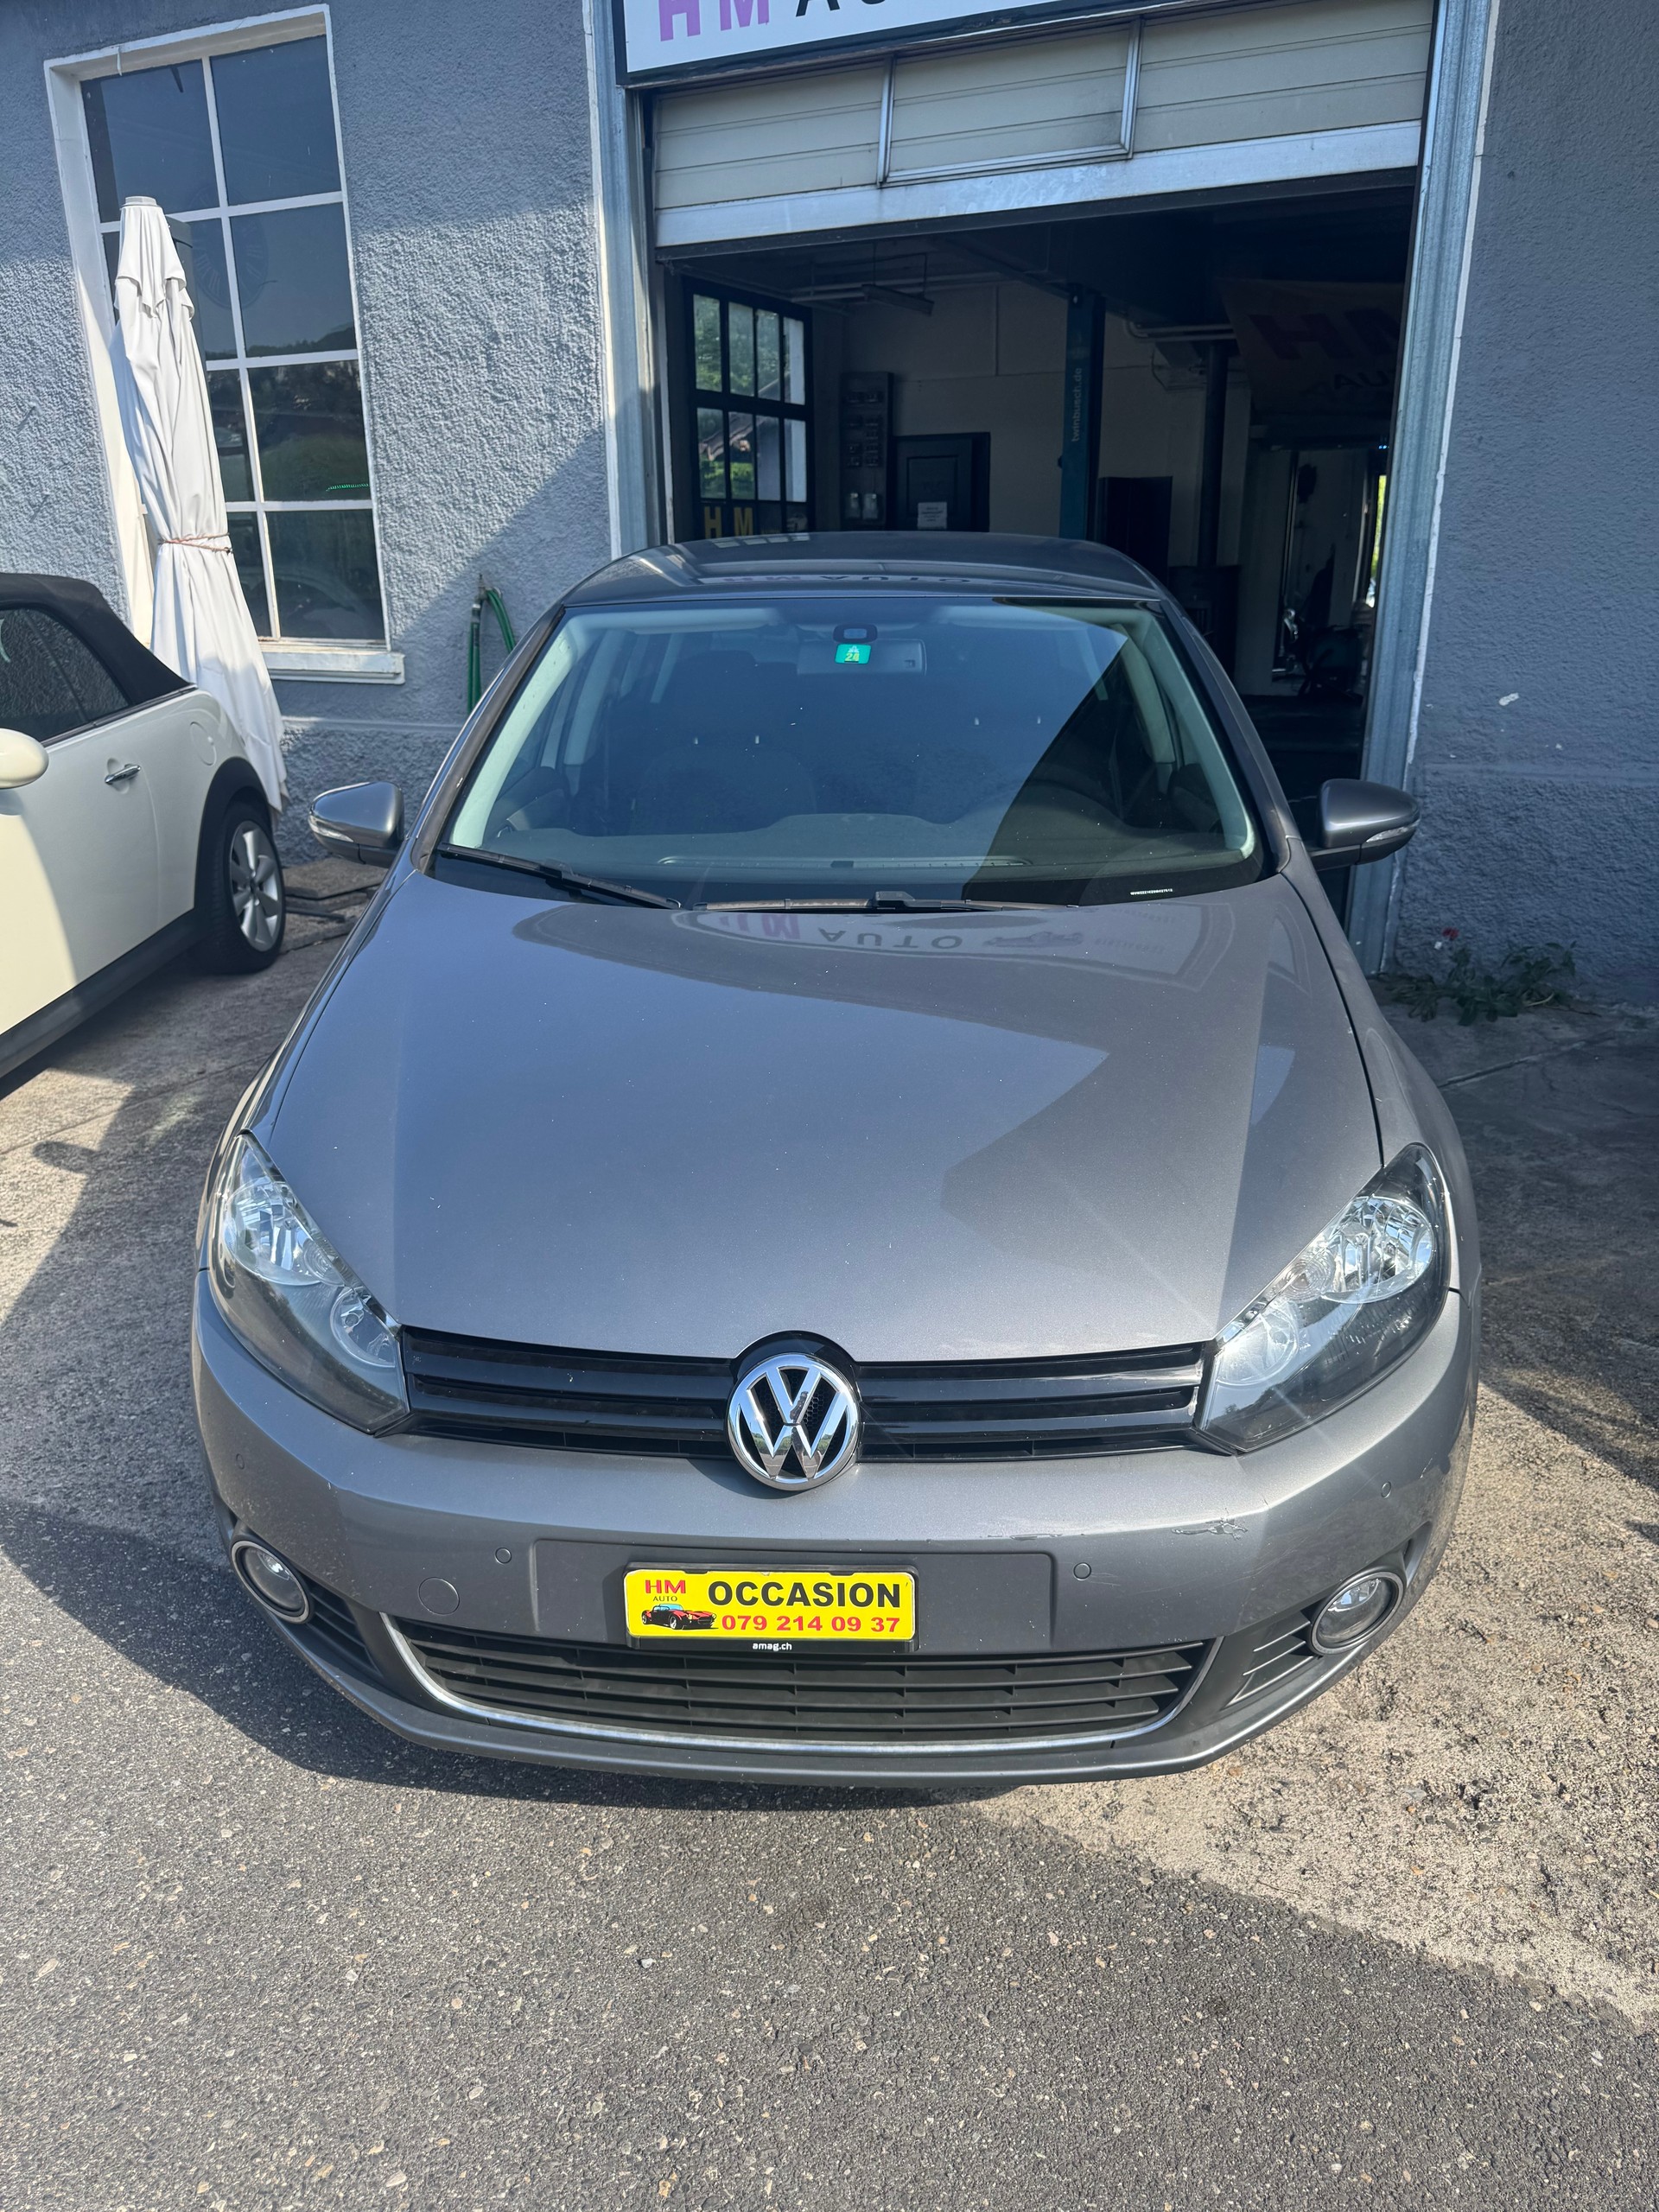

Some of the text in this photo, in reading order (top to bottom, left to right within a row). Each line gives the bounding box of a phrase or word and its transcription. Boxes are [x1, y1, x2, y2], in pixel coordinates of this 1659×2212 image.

[1334, 369, 1395, 390] AU
[1071, 367, 1082, 442] twinbusch.de
[732, 1357, 855, 1486] VW
[645, 1580, 687, 1595] HM
[708, 1580, 900, 1608] OCCASION
[721, 1615, 900, 1633] 079 214 09 37
[752, 1642, 792, 1652] amag.ch
